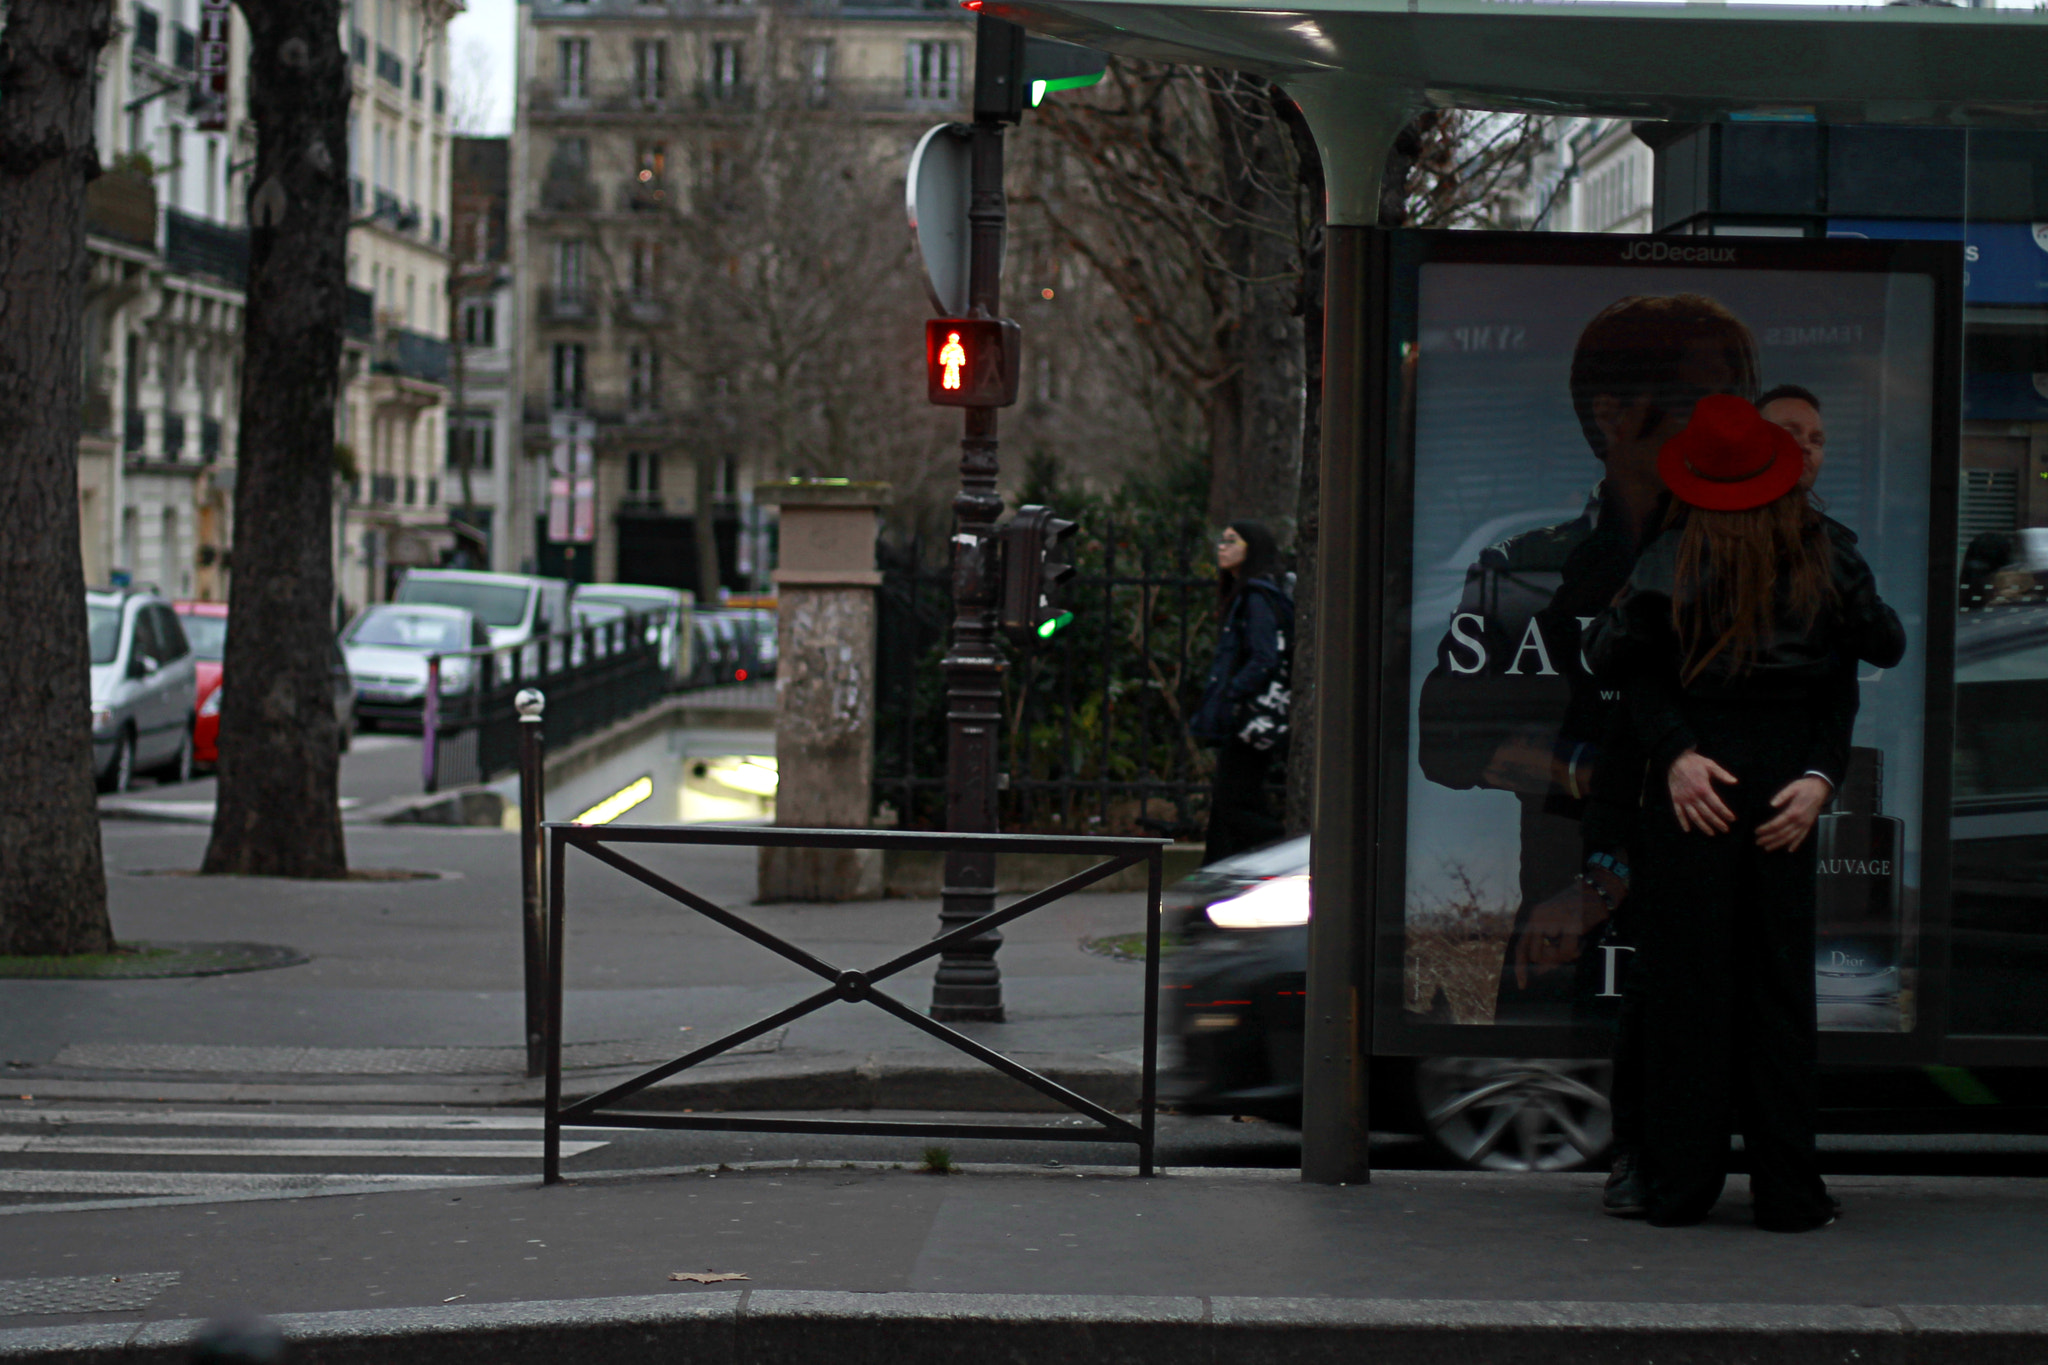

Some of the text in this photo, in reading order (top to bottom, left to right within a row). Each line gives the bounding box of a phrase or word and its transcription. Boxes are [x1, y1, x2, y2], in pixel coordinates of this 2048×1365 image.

[1620, 240, 1736, 262] JCDecaux
[1816, 858, 1891, 876] AUVAGE
[1830, 950, 1865, 967] Dior
